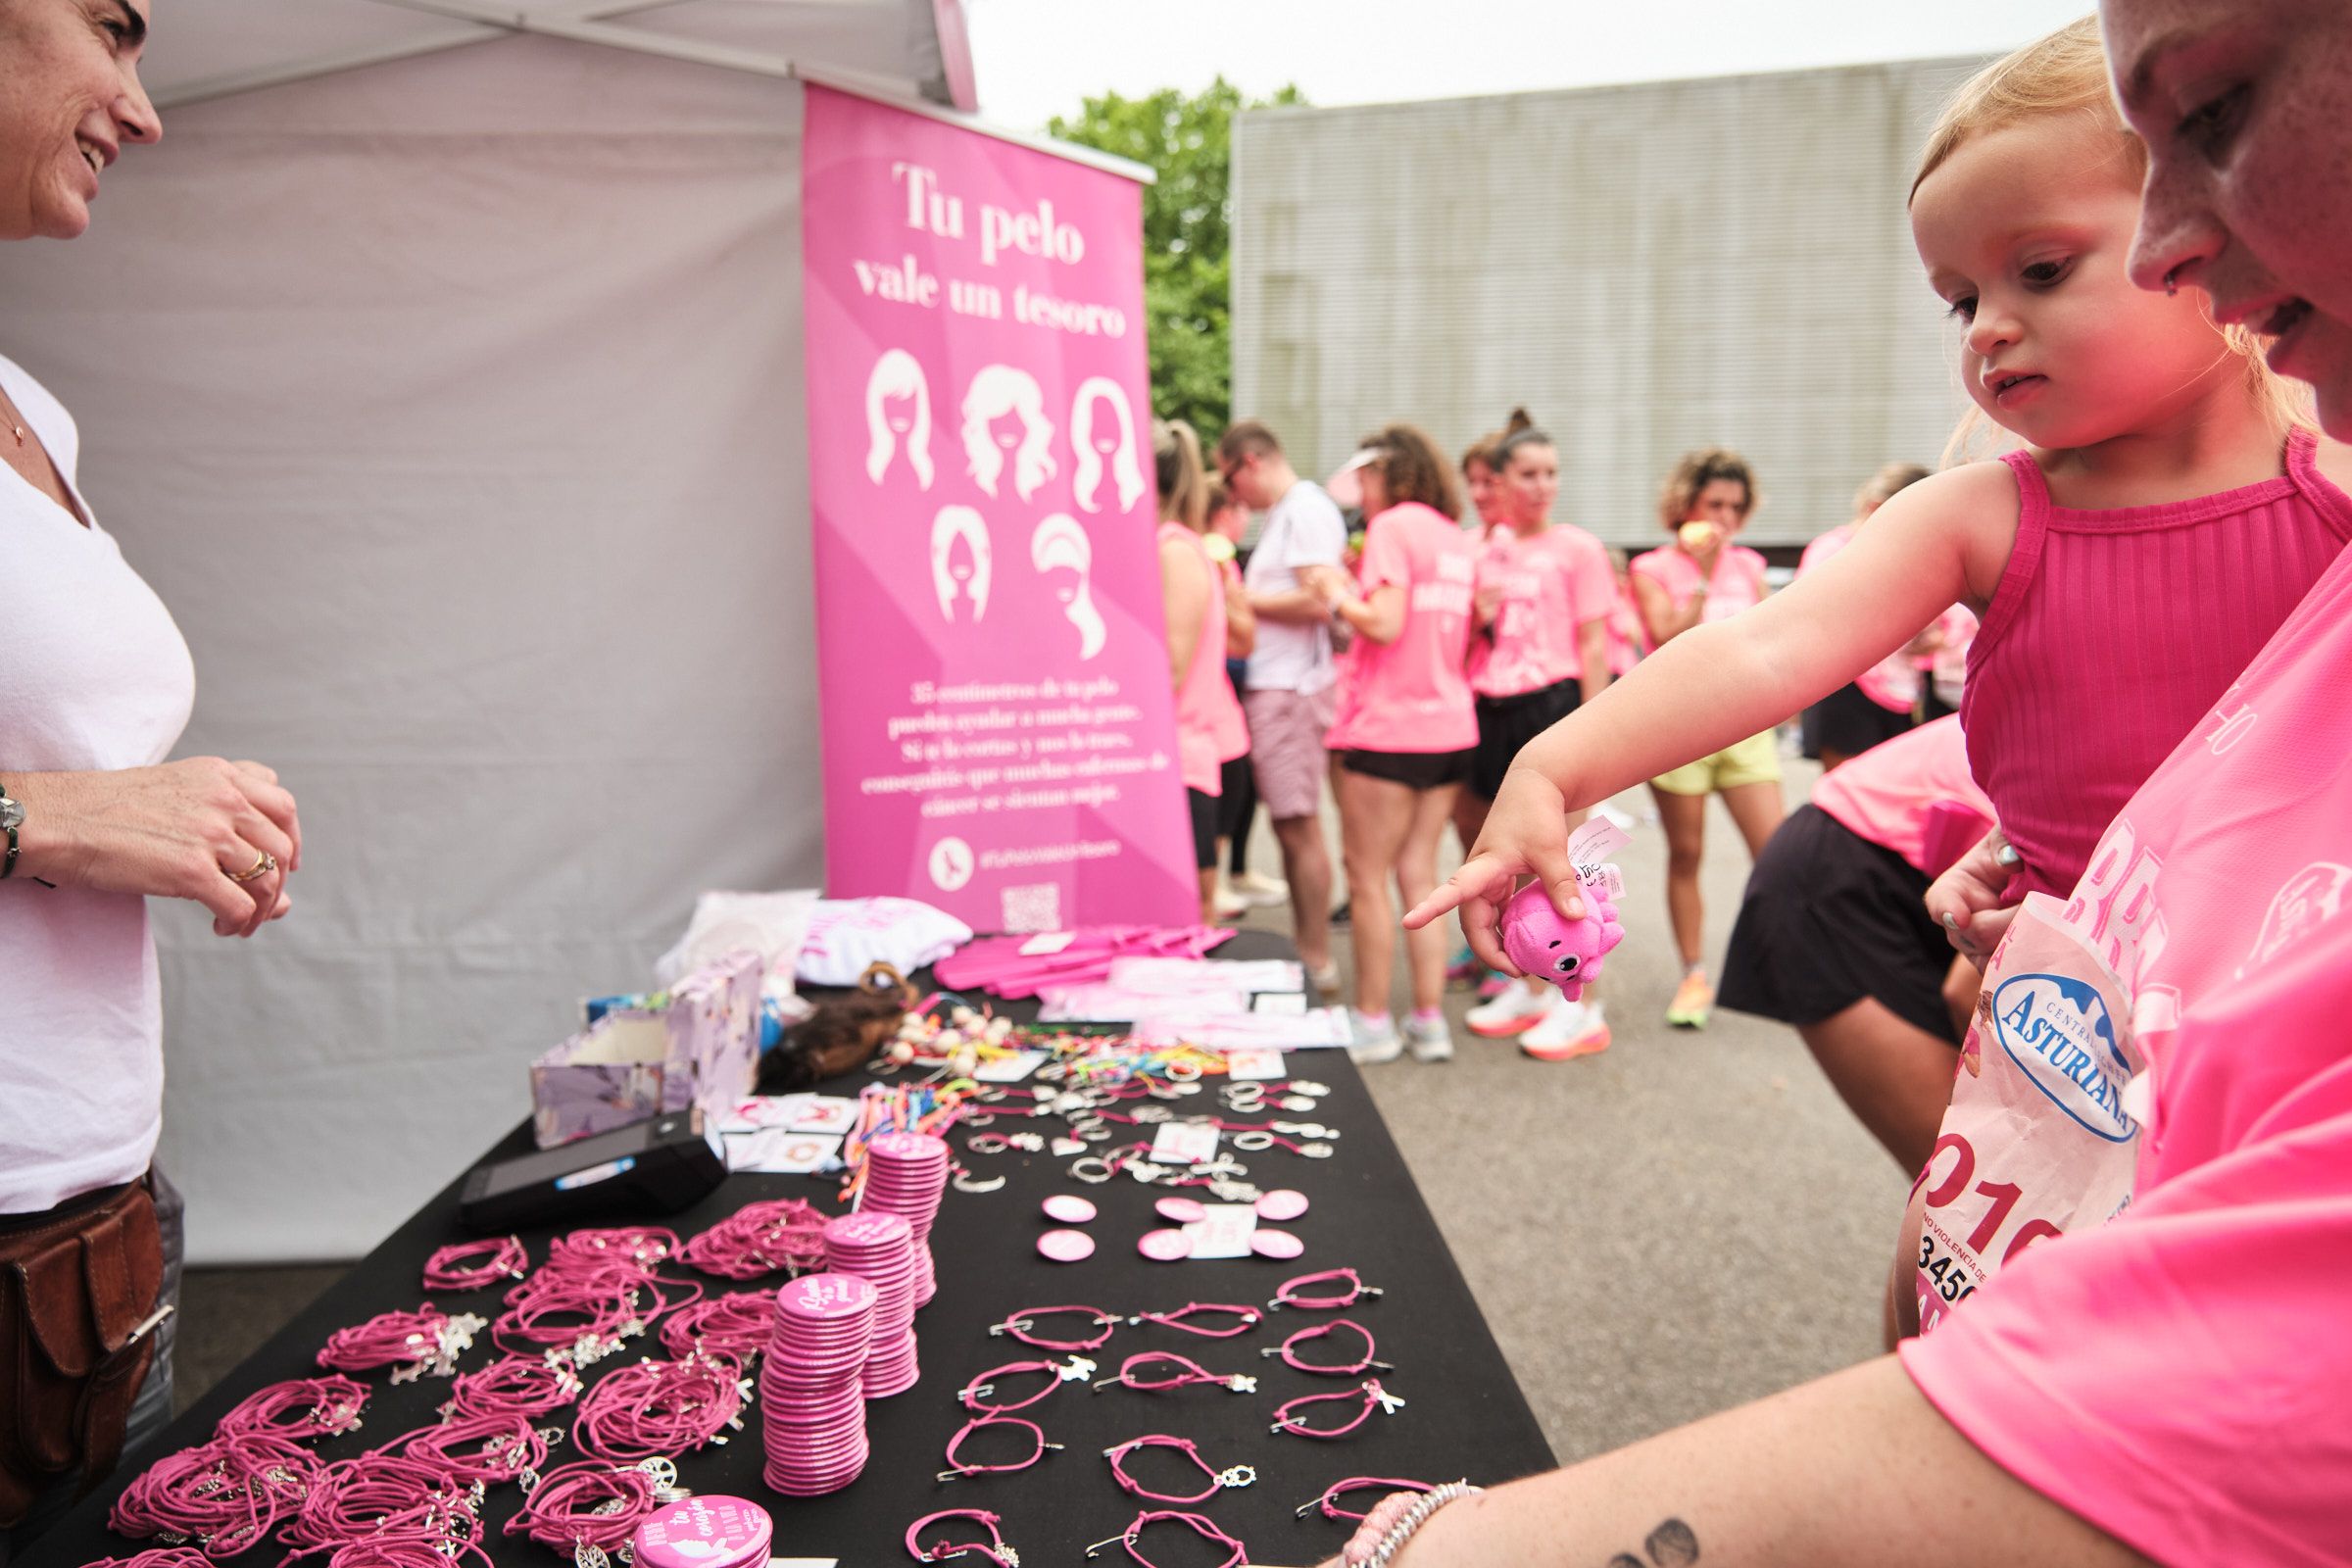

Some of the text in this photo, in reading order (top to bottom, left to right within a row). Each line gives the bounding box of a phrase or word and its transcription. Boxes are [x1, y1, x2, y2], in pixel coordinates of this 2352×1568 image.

[892, 161, 1084, 266] Tu pelo
[853, 254, 1126, 338] vale un tesoro
[2045, 1002, 2096, 1049] CENTRAL
[1933, 1224, 1978, 1272] VIOLENCIA
[1975, 1268, 1986, 1283] DE
